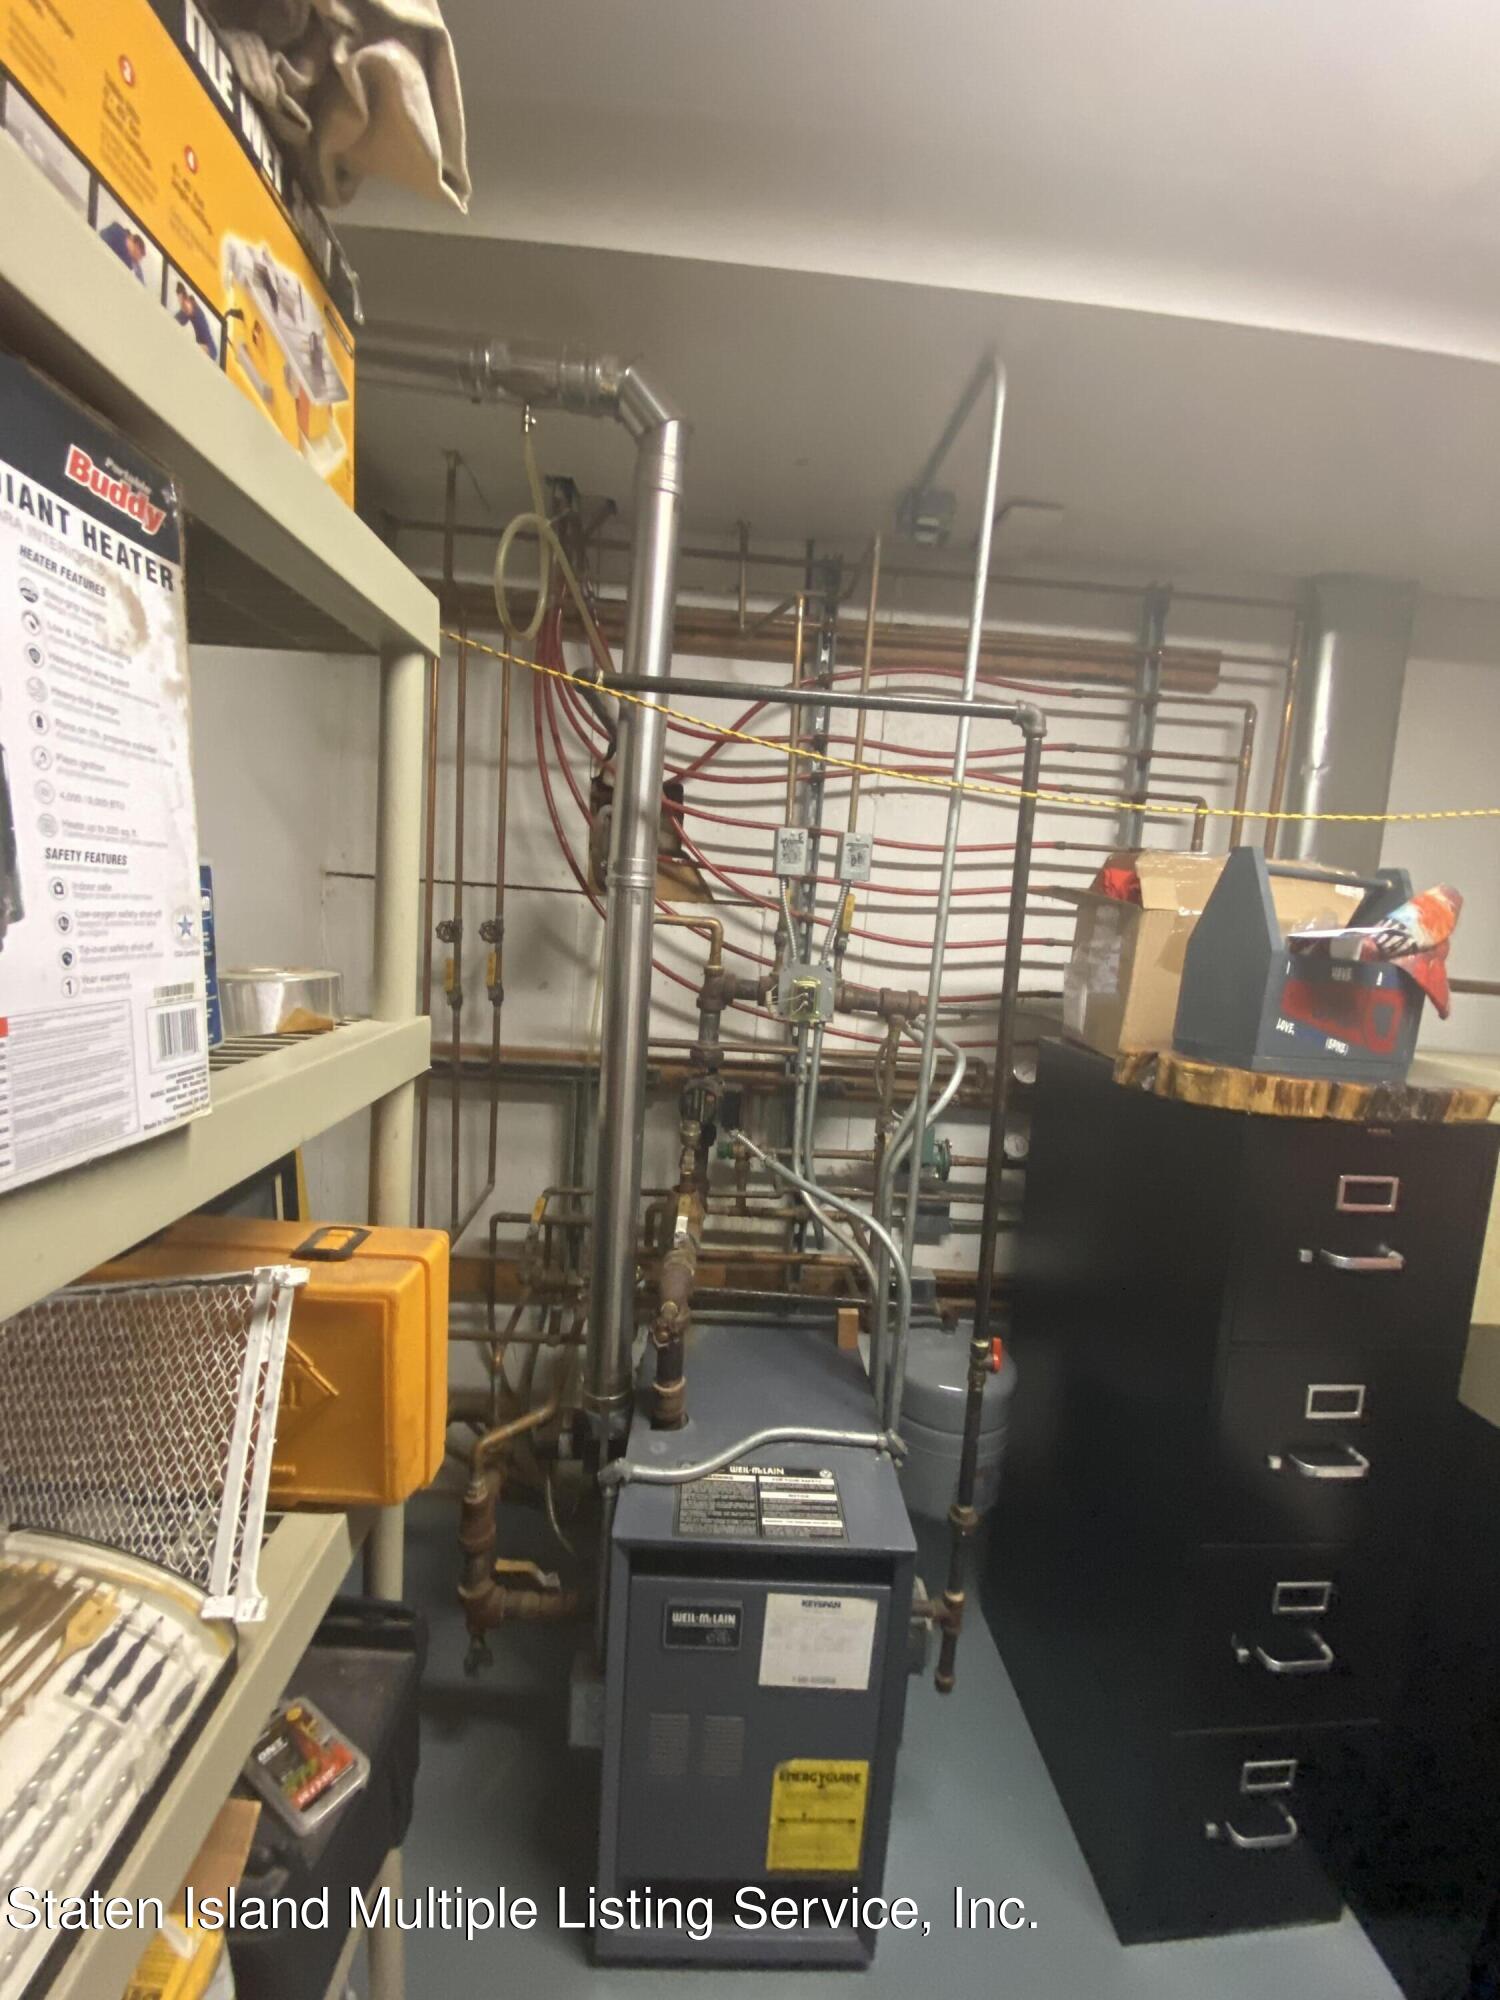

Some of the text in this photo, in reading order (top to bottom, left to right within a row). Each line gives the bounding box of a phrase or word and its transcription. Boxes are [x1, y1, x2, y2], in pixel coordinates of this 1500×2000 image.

[65, 443, 166, 535] Buddy
[0, 470, 70, 535] IANT
[82, 520, 174, 592] HEATER
[20, 544, 58, 574] HEATER
[60, 566, 106, 597] FEATURES
[45, 847, 128, 866] SAFETY FEATURES
